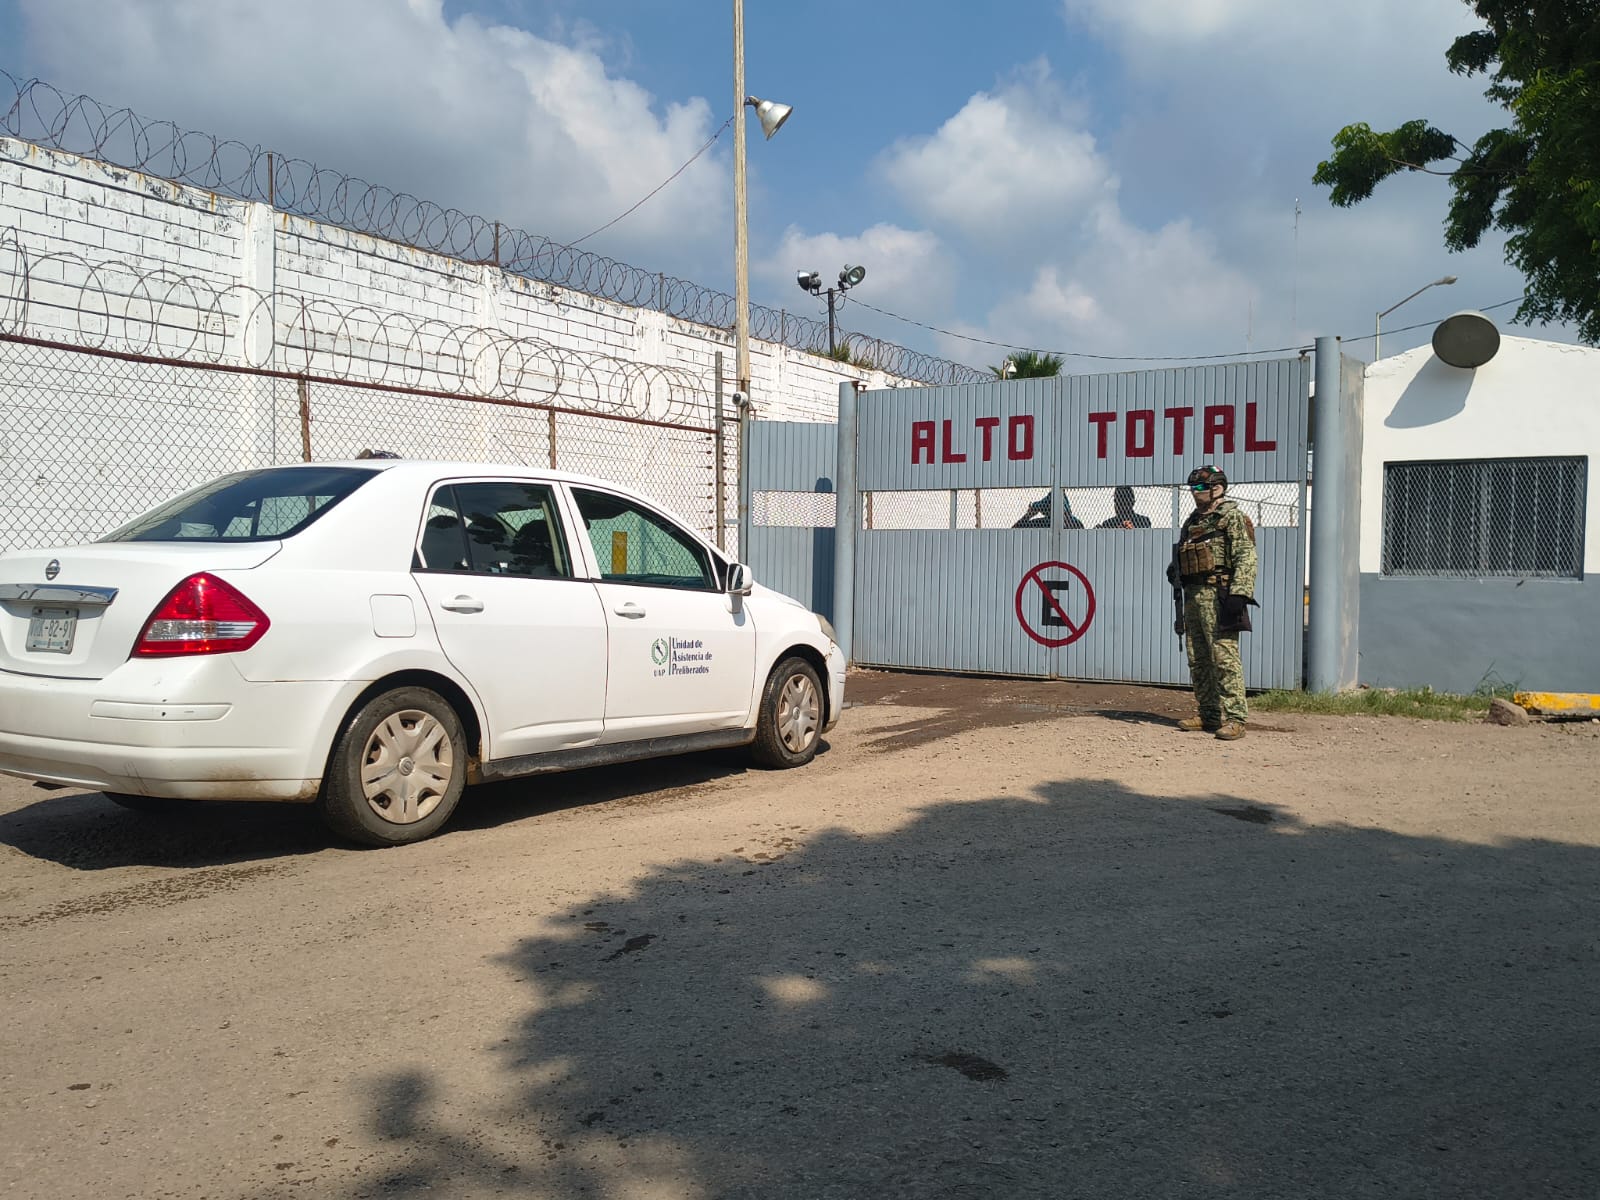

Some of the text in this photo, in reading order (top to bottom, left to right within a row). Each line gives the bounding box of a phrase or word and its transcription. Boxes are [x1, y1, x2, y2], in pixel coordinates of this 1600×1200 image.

[911, 402, 1276, 465] ALTO TOTAL
[1042, 580, 1070, 627] E
[672, 637, 703, 649] Unidad de
[672, 650, 713, 661] Asistencia de
[672, 663, 709, 675] Preliberados
